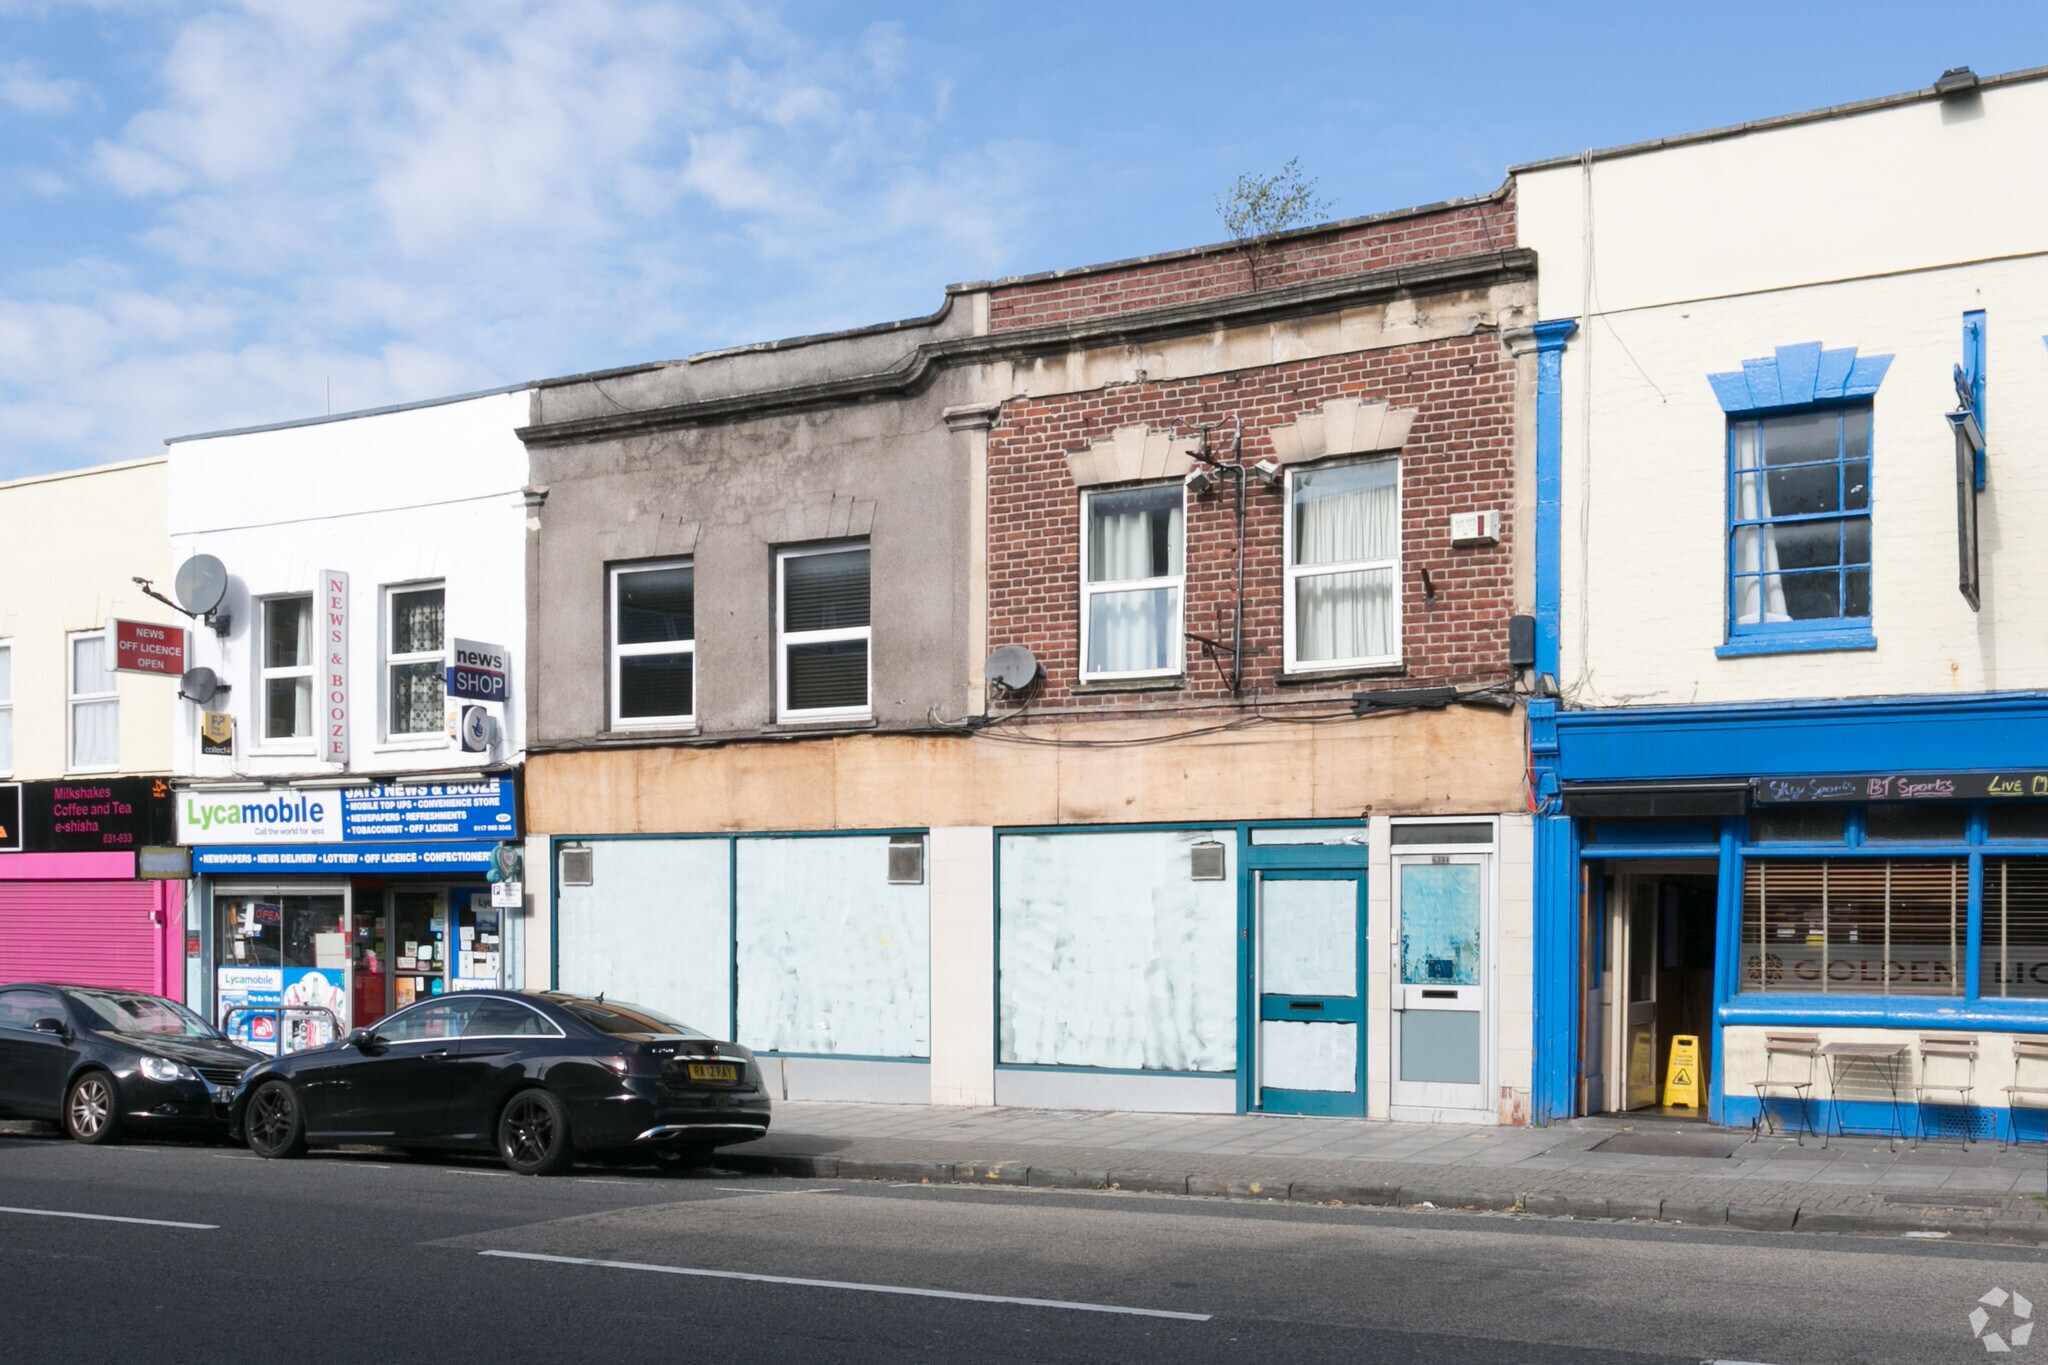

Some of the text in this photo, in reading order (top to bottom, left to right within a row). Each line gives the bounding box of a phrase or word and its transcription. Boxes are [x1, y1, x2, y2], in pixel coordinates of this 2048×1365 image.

[136, 628, 165, 640] NEWS
[119, 640, 182, 656] OFF LICENCE
[137, 658, 165, 669] OPEN
[457, 649, 502, 668] news
[329, 579, 344, 754] NEWS & BOOZE
[456, 672, 503, 694] SHOP
[54, 787, 111, 800] Milkshakes
[384, 783, 428, 797] NEWS
[1898, 778, 1956, 798] Sports
[54, 801, 132, 816] Coffee and Tea
[350, 797, 500, 810] MOBILE TOP UPS CONVENIENCE STORE
[187, 796, 324, 831] Lycamobile
[350, 810, 468, 823] NEWSPAPERS REFRESHMENTS
[55, 820, 98, 832] e-shisha
[255, 827, 267, 836] Call
[268, 827, 279, 836] the
[280, 827, 298, 836] world
[300, 827, 308, 836] for
[351, 823, 459, 835] TOBACCONIST OFF LICENCE
[103, 833, 133, 844] 631-633
[203, 854, 252, 864] NEWSPAPERS
[257, 853, 280, 864] NEWS
[280, 853, 318, 863] DELIVERY
[322, 852, 359, 864] LOTTERY
[364, 853, 381, 864] OFF
[381, 852, 418, 863] LICENCE
[256, 909, 281, 921] OPEN
[1794, 959, 1959, 984] GOLDEN
[225, 973, 274, 986] Lycamobile
